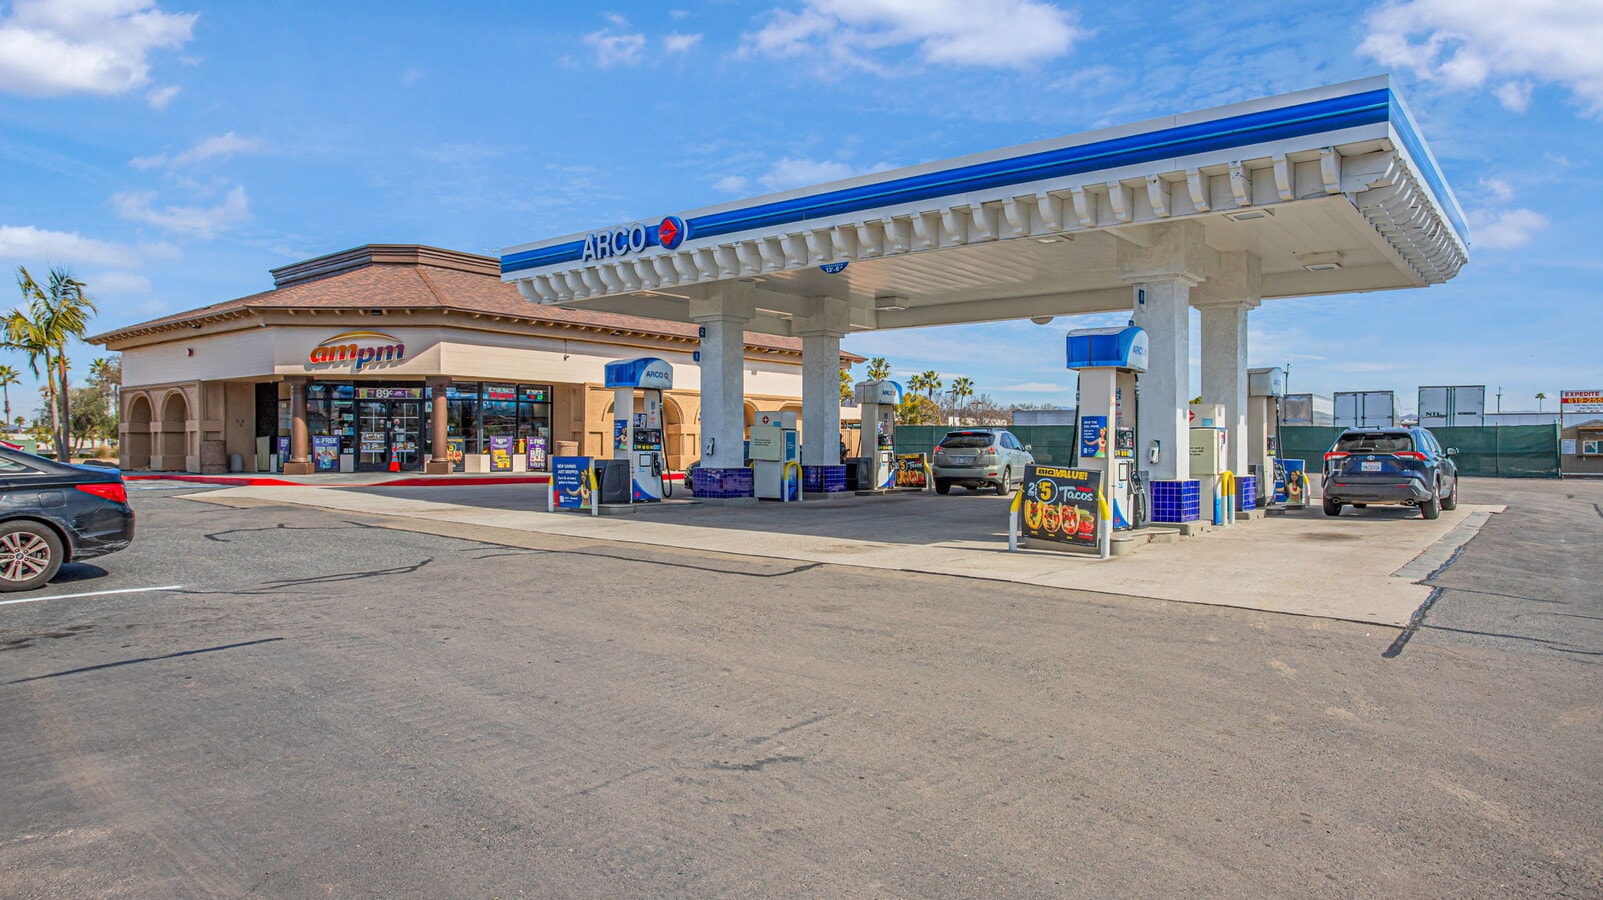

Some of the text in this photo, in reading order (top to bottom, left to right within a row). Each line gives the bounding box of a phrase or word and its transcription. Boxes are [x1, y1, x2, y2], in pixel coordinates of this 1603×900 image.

[581, 223, 647, 262] ARCO
[309, 343, 405, 370] ampm
[645, 370, 664, 378] ARCO
[1055, 468, 1088, 480] VALUE!
[1028, 482, 1035, 494] 2
[1059, 485, 1093, 503] Tacos
